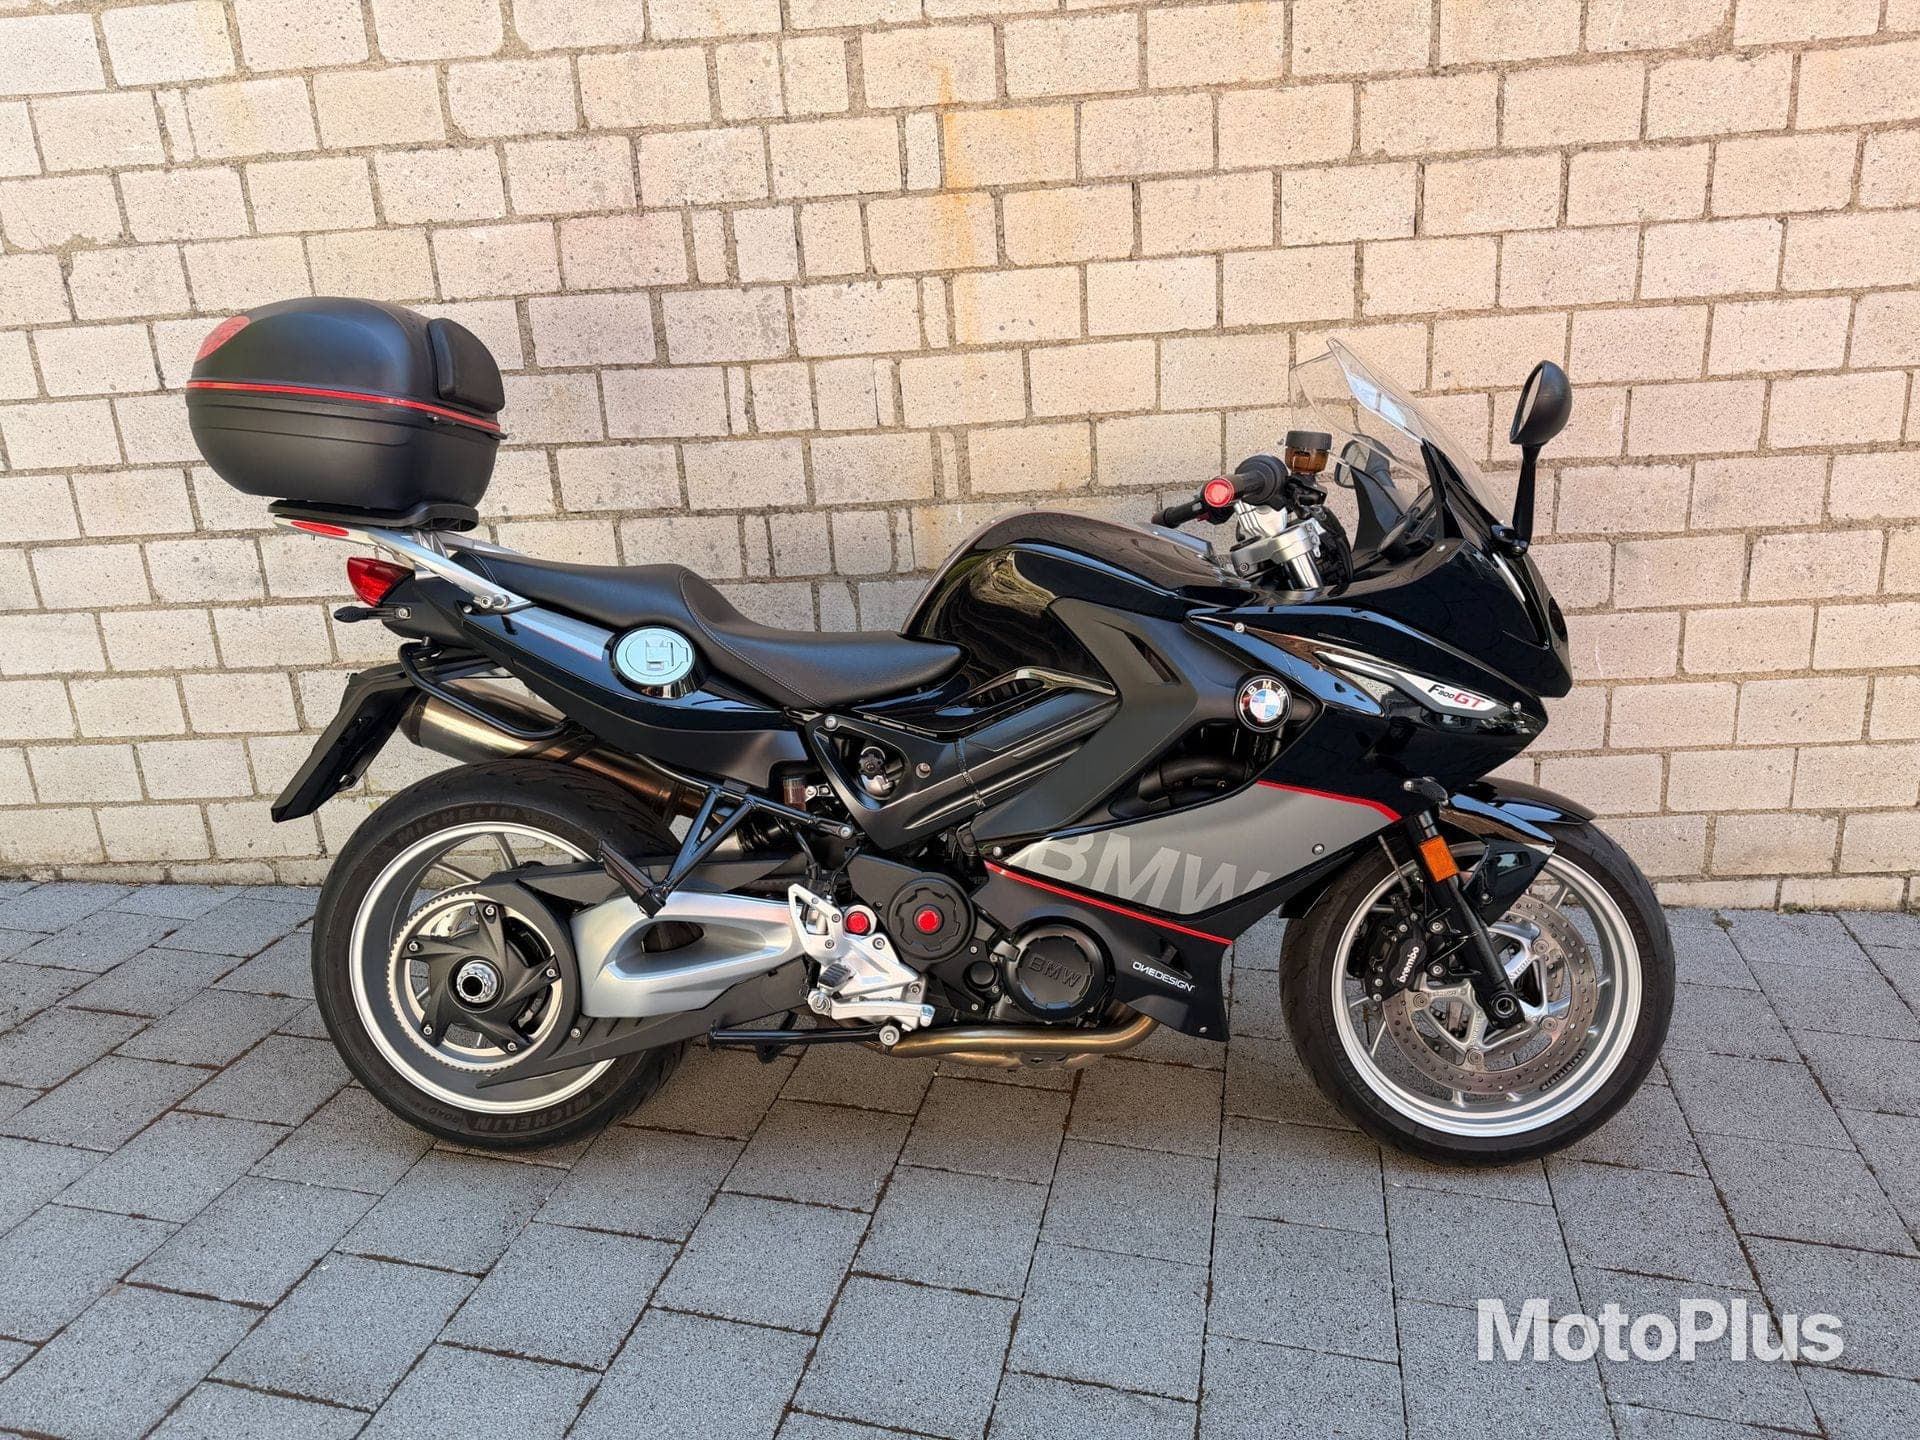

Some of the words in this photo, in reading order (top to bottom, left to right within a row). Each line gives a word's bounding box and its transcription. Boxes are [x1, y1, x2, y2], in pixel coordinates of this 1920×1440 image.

[1246, 680, 1288, 697] BMW
[396, 804, 515, 845] MICHELIN
[1027, 956, 1082, 988] BMW
[1396, 946, 1420, 984] brembo
[474, 1090, 592, 1131] MICHELIN
